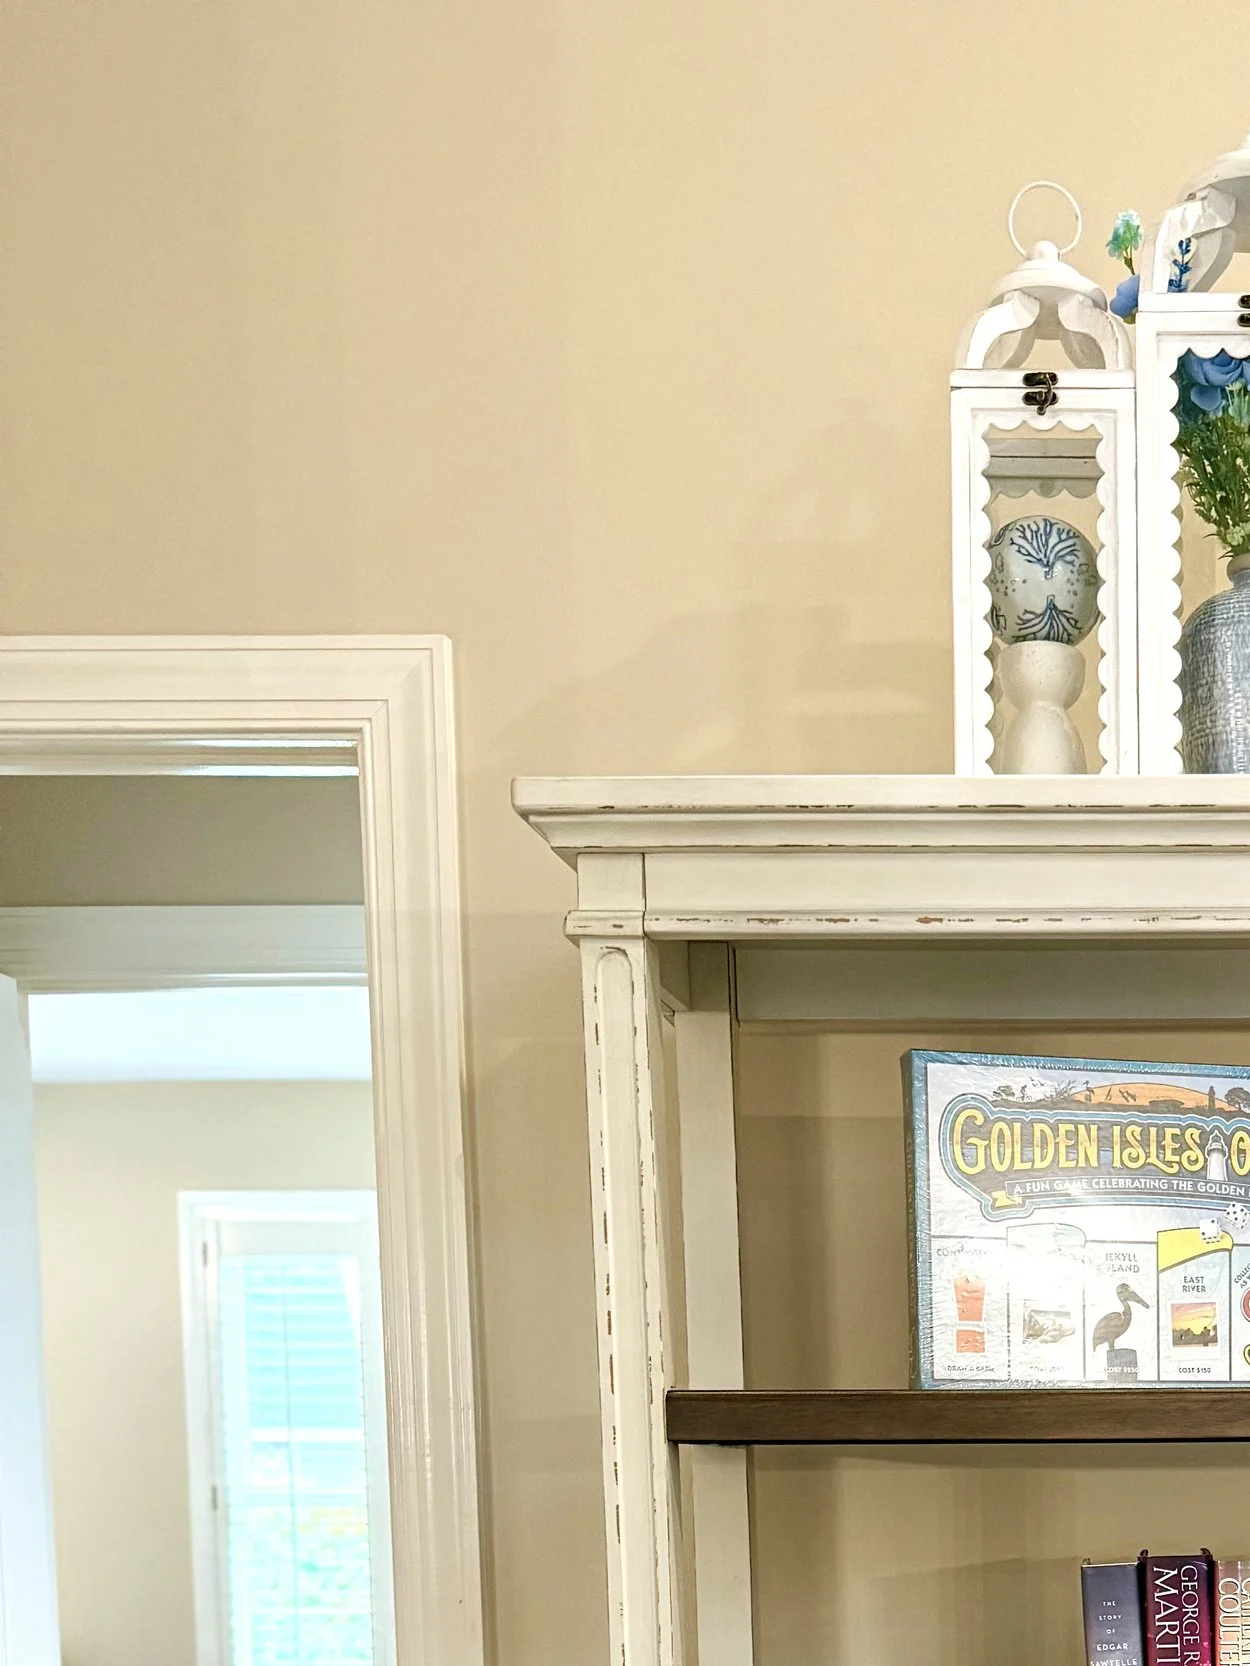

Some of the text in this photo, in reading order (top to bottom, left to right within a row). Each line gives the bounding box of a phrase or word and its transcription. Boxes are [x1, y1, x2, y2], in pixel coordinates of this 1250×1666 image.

[953, 1108, 1098, 1175] GOLDEN
[1112, 1123, 1205, 1175] ISLES
[1013, 1185, 1023, 1195] A
[1025, 1181, 1050, 1193] FUN
[1053, 1179, 1088, 1191] GAME
[1092, 1177, 1168, 1190] CELEBRATING
[1171, 1179, 1193, 1191] THE
[1197, 1181, 1245, 1197] GOLDEN
[1183, 1276, 1205, 1284] EAST
[1182, 1285, 1207, 1293] RIVER
[1180, 1564, 1200, 1646] GEORGE
[1096, 1642, 1129, 1652] EDGAR
